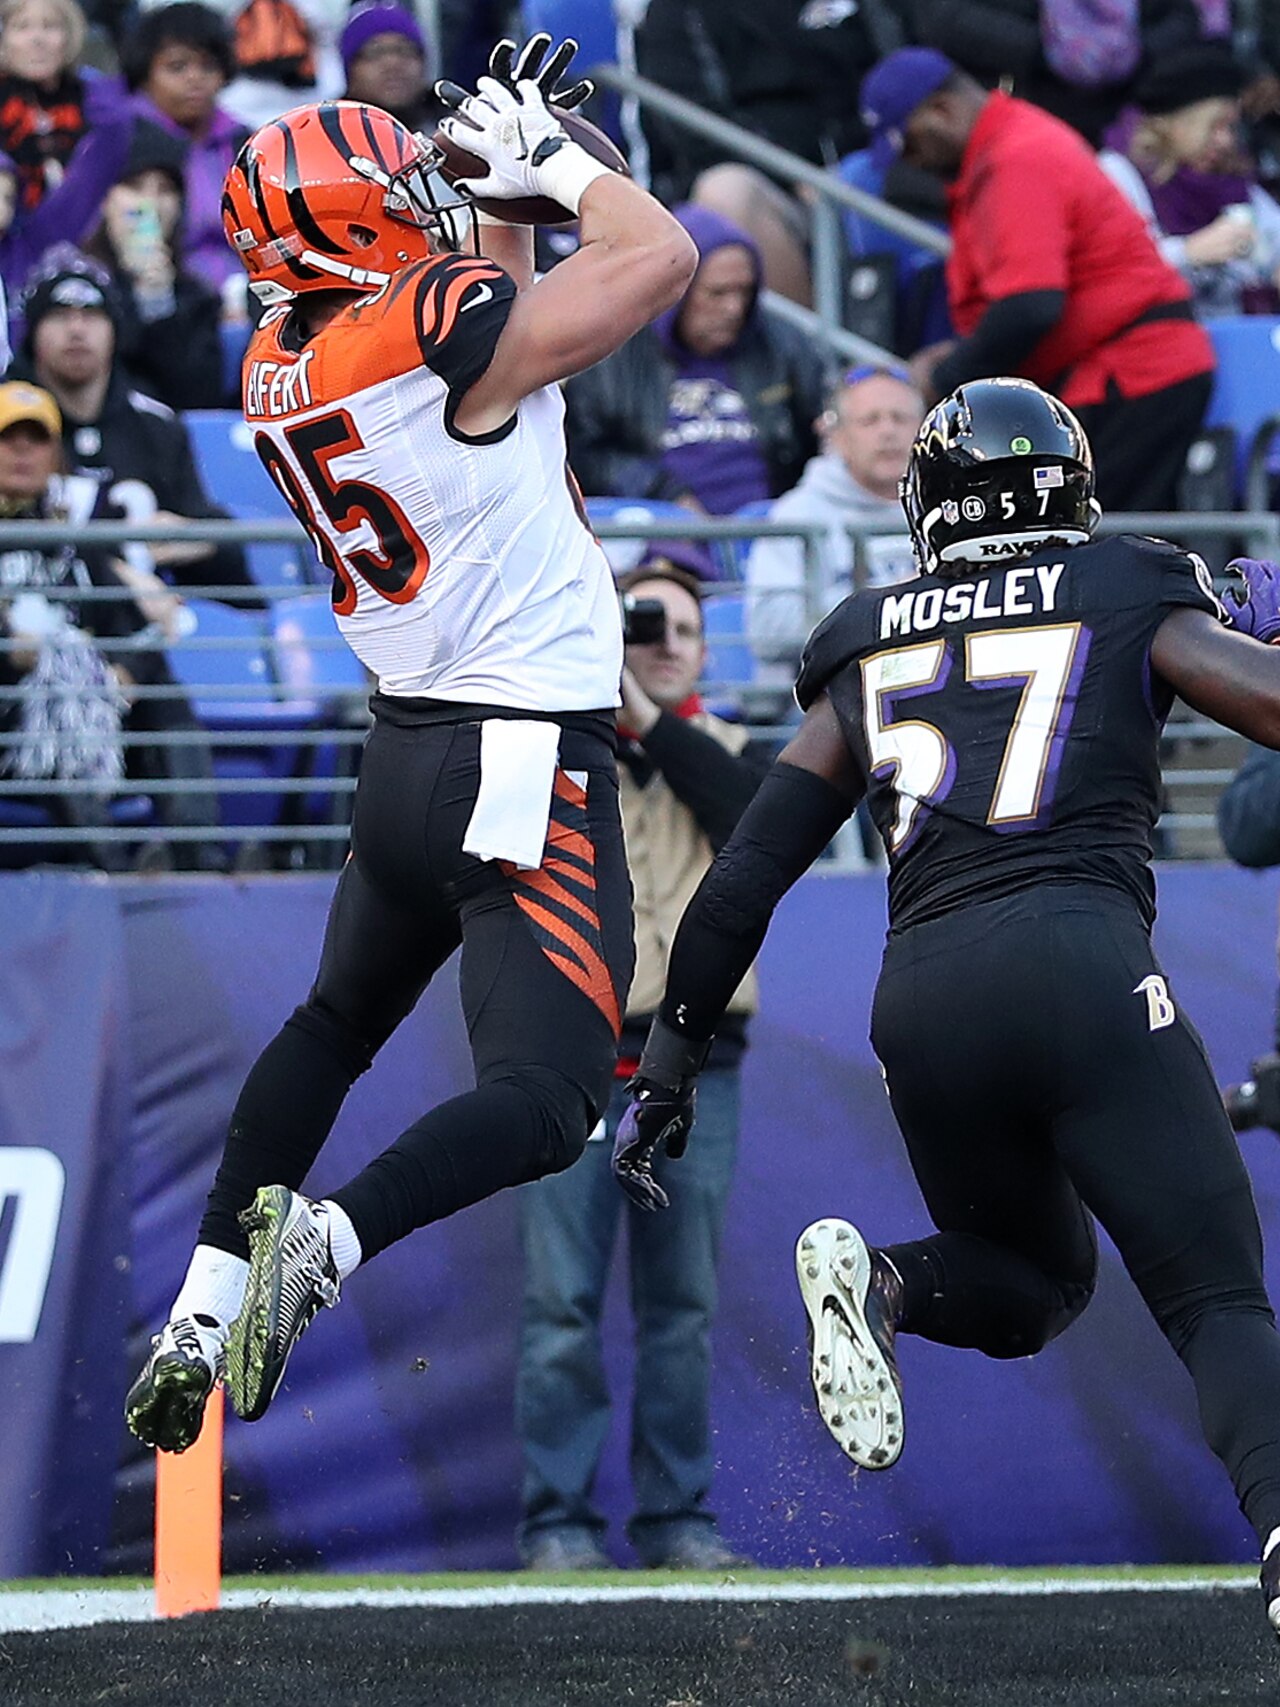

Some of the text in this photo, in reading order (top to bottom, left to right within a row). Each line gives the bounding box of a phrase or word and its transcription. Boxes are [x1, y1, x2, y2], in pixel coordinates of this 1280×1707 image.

[965, 500, 983, 517] CB
[880, 563, 1065, 640] MOSLEY
[859, 621, 1092, 852] 57
[1133, 974, 1175, 1031] B
